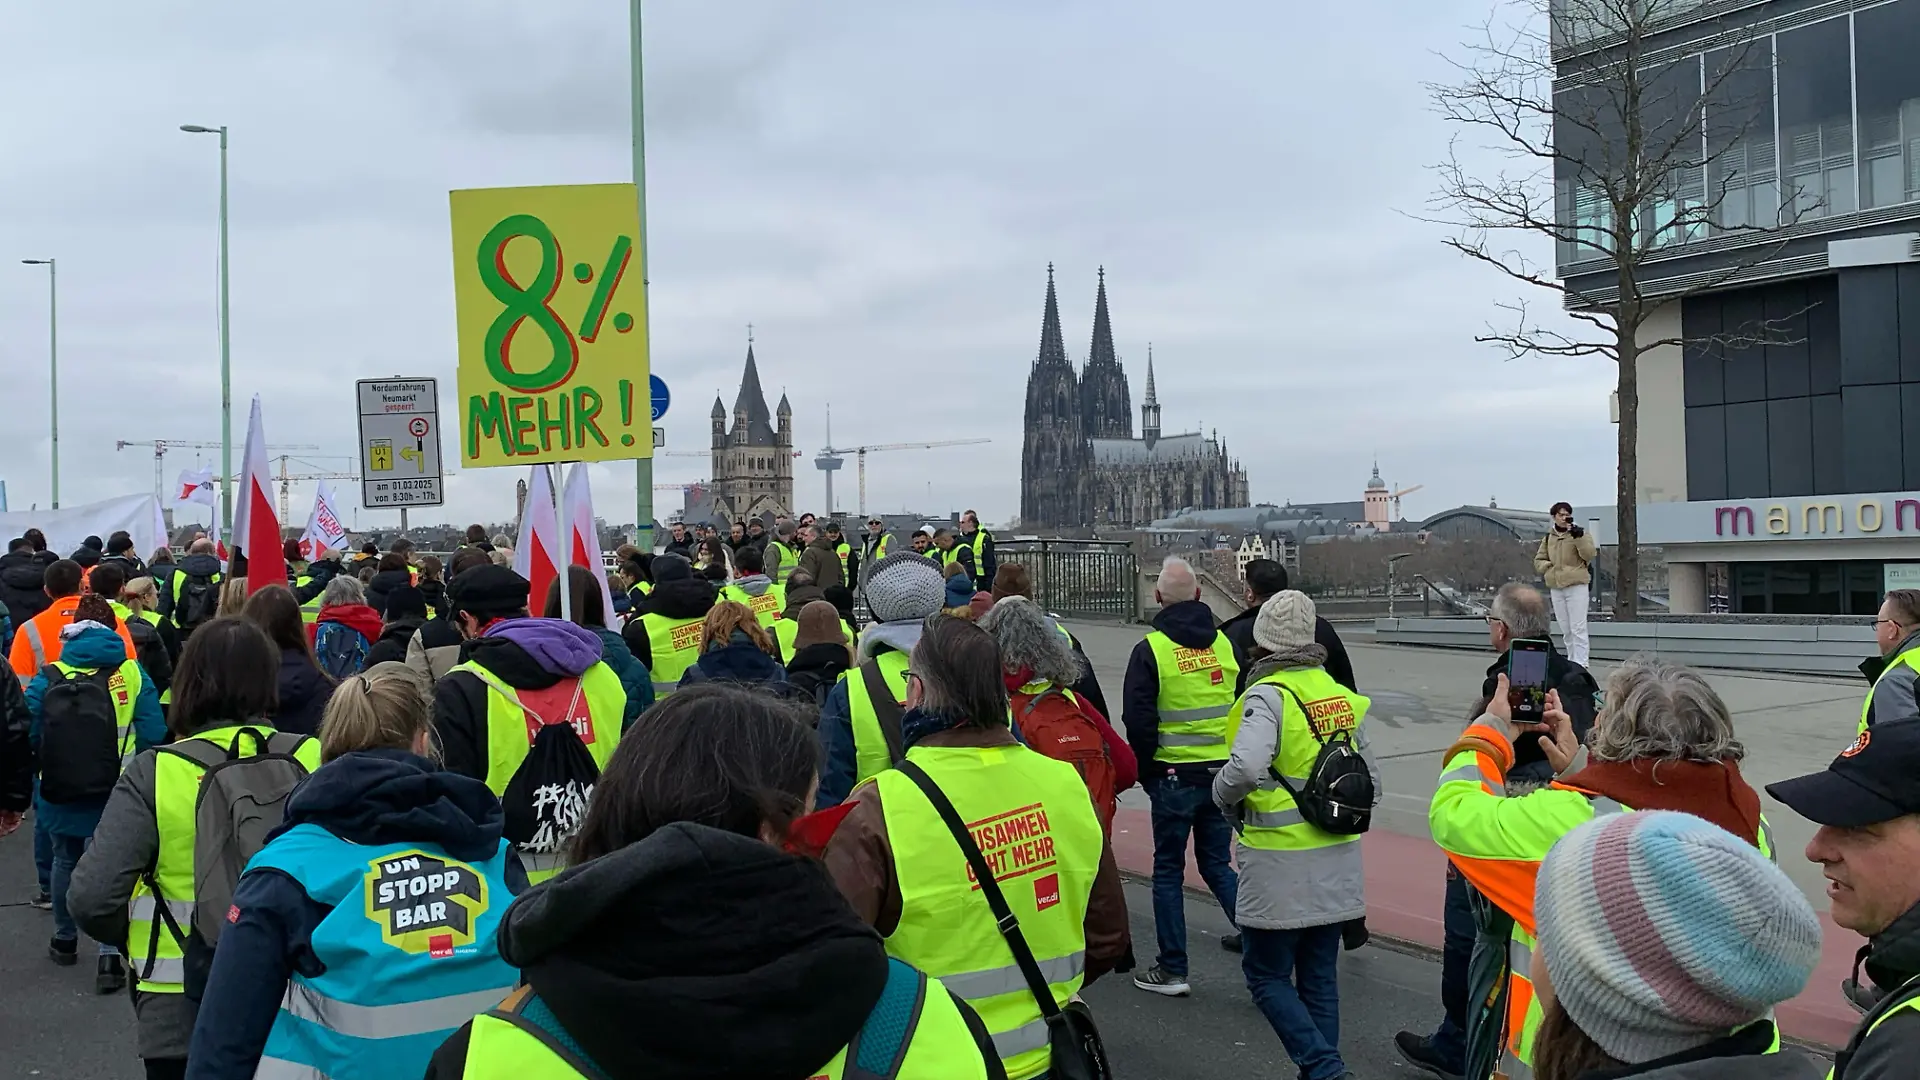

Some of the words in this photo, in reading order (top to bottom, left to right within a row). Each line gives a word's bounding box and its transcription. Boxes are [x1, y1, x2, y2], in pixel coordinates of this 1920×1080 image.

[477, 214, 634, 393] 8%
[371, 383, 426, 392] Nordumfahrung
[382, 394, 416, 402] Neumarkt
[385, 403, 414, 412] gesperrt
[393, 480, 432, 490] 01.03.2025
[393, 492, 413, 501] 8:30h
[422, 491, 435, 500] 17h
[673, 636, 691, 649] GEHT
[691, 633, 702, 644] ME
[1174, 646, 1216, 661] ZUSAMMEN
[1178, 659, 1198, 671] GEHT
[110, 675, 126, 687] EHR
[1308, 700, 1353, 720] USAMMEN
[1334, 712, 1355, 729] MEHR
[970, 810, 1050, 852] USAMMEN
[1012, 836, 1056, 868] MEHR
[385, 857, 420, 874] UN
[379, 870, 460, 903] STOPP
[1037, 893, 1058, 904] ver.di
[396, 901, 447, 928] BAR
